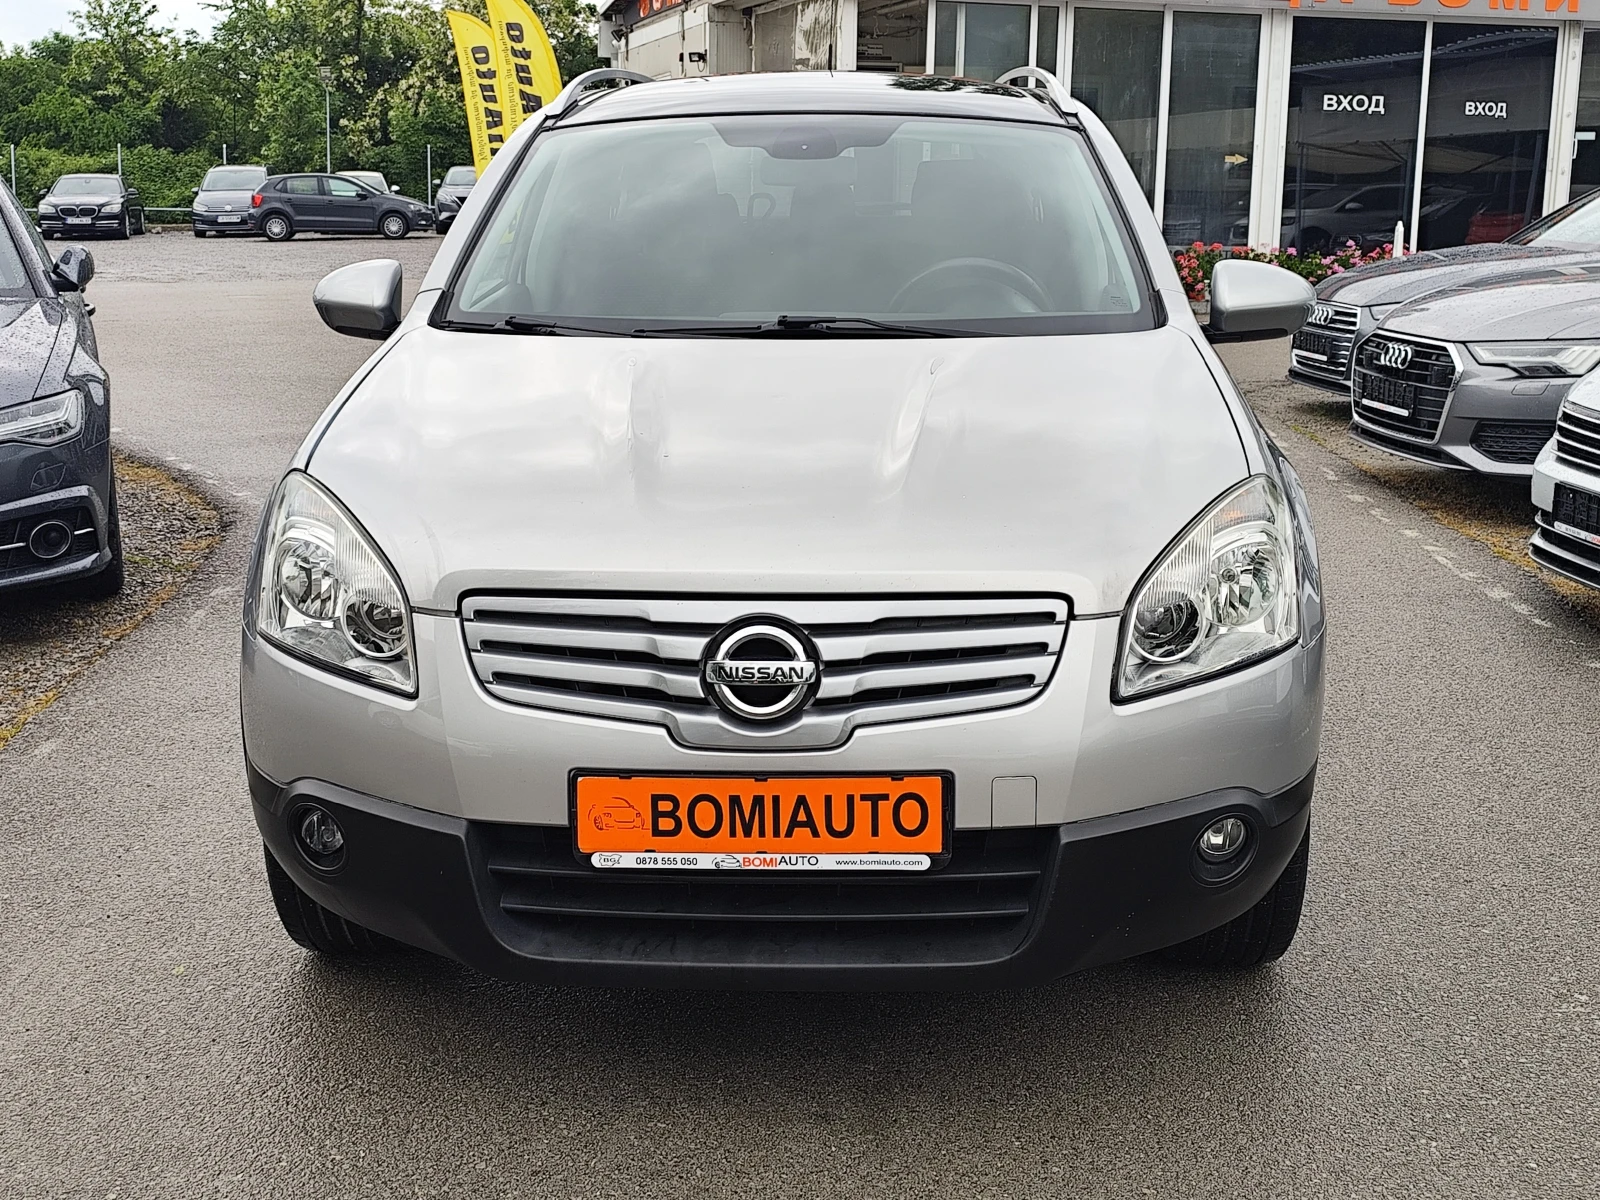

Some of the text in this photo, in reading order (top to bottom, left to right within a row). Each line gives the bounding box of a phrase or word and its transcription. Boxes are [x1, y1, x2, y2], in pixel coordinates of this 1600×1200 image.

[1322, 94, 1385, 115] ВХОД
[1464, 101, 1507, 119] ВХОД
[716, 666, 804, 680] NISSAN
[650, 791, 930, 839] BOMIAUTO
[635, 856, 698, 867] 0878 555 050
[742, 855, 818, 868] BOMIAUTO
[835, 858, 923, 867] www.bomiauto.com
